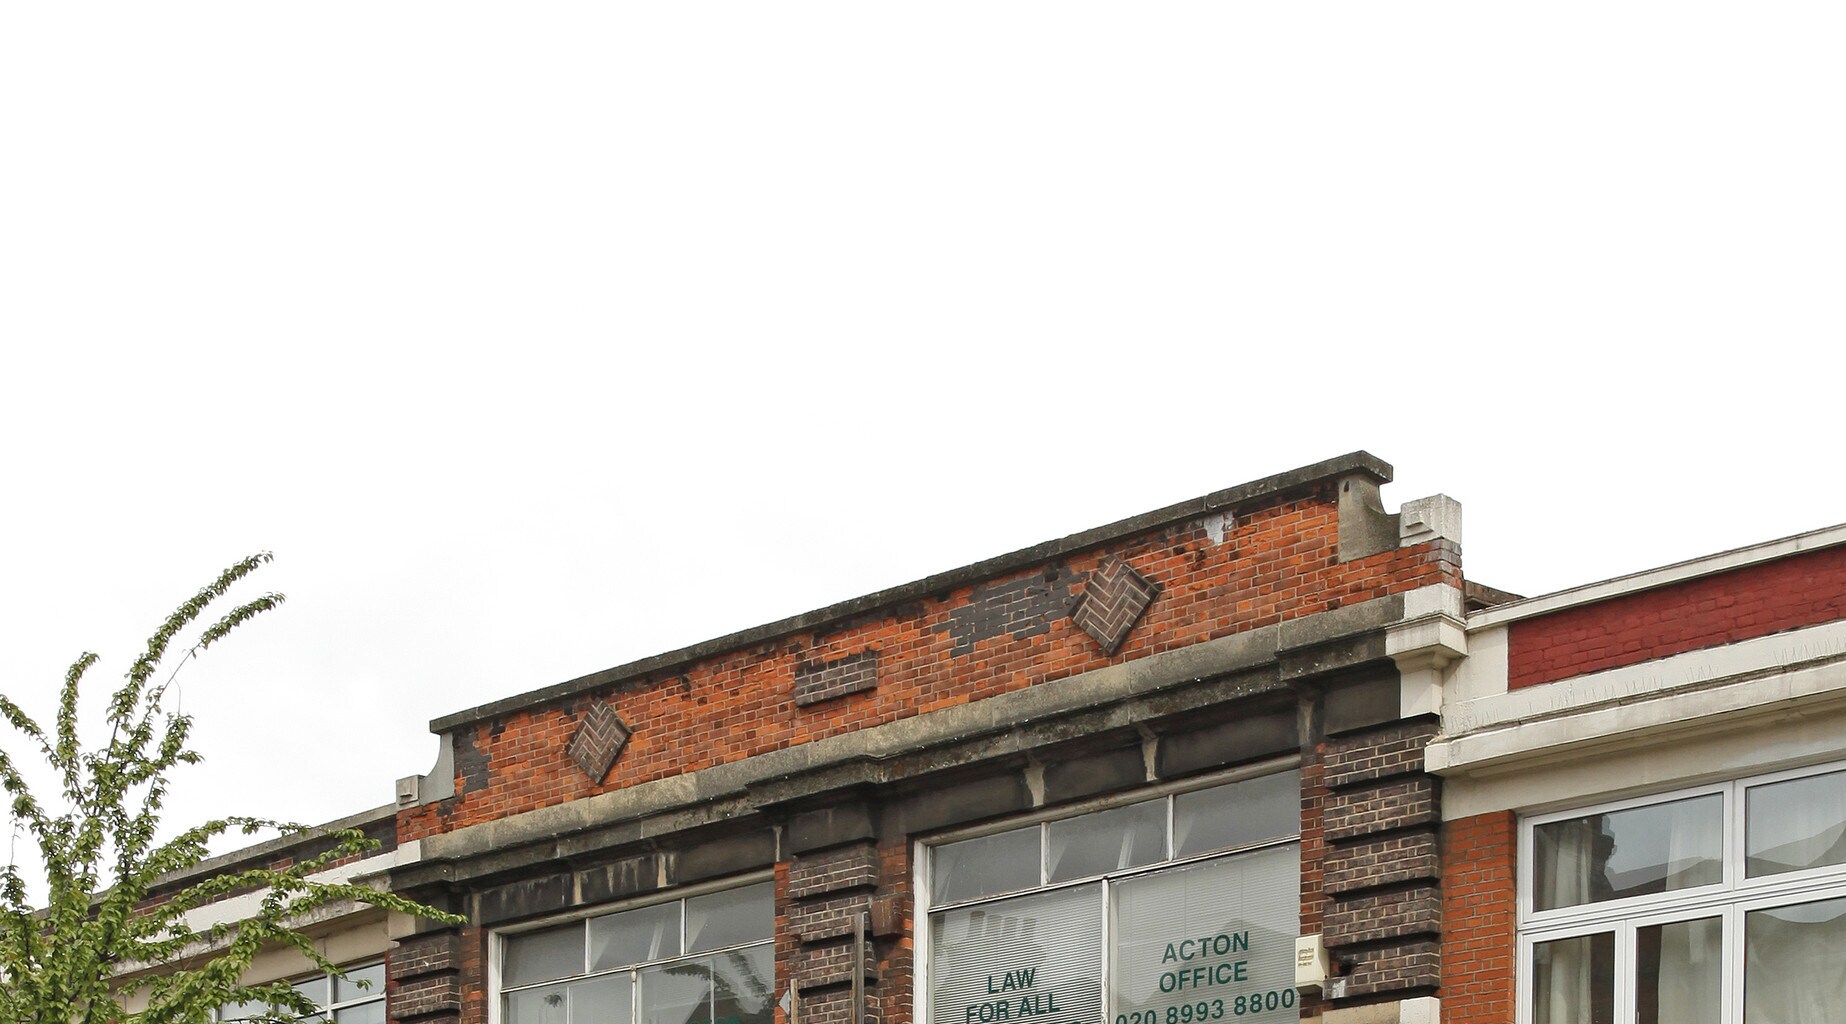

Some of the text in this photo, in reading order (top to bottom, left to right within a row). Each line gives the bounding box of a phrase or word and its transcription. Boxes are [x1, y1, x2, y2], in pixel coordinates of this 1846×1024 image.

[1162, 931, 1249, 964] ACTON
[988, 967, 1036, 994] LAW
[1159, 961, 1248, 993] OFFICE
[966, 992, 1060, 1024] FOR ALL
[1233, 988, 1295, 1016] 8800
